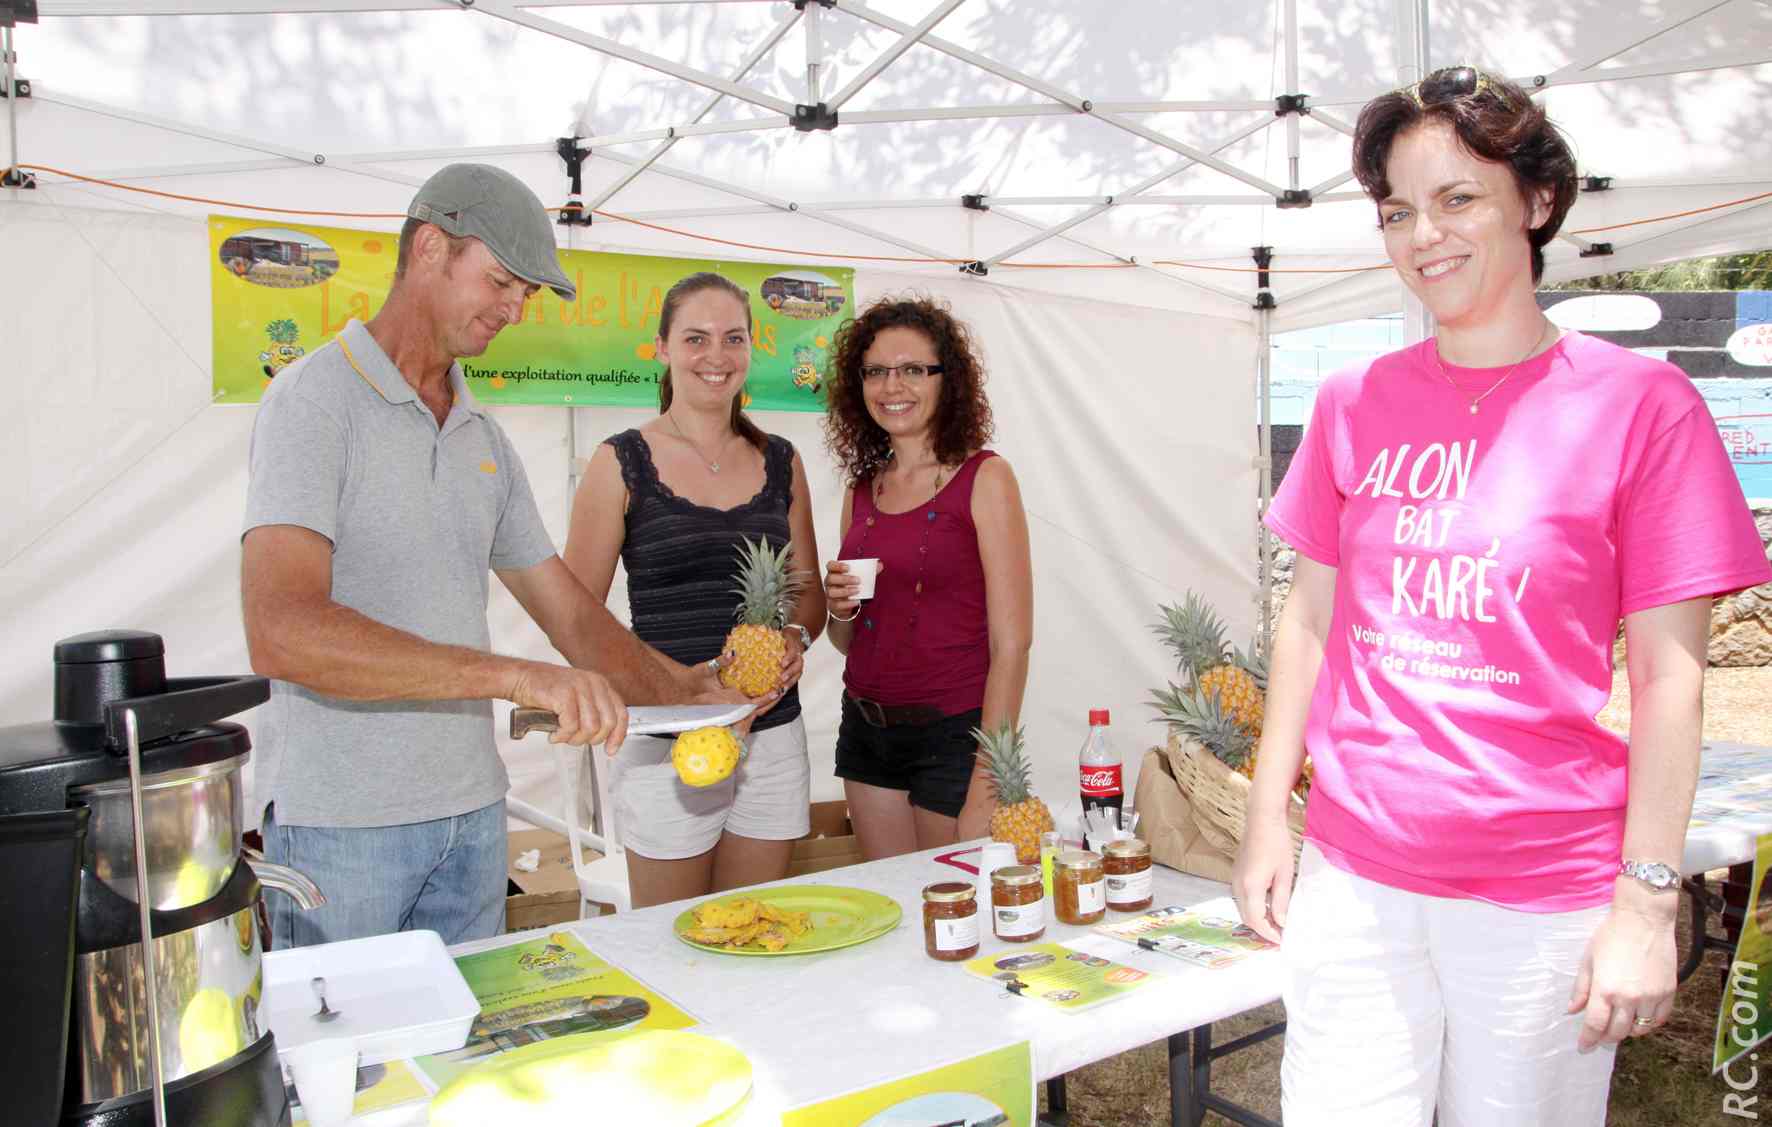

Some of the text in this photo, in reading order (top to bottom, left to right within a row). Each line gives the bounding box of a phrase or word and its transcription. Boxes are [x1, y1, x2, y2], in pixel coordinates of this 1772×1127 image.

[322, 281, 368, 336] La
[559, 270, 609, 327] de
[502, 366, 582, 384] exploitation
[586, 369, 640, 387] qualifiée
[1354, 439, 1477, 500] ALON
[1394, 505, 1461, 547] BAT
[1391, 536, 1501, 623] KARÉ
[1352, 624, 1461, 659] Votre réseau
[1381, 653, 1520, 685] de réservation
